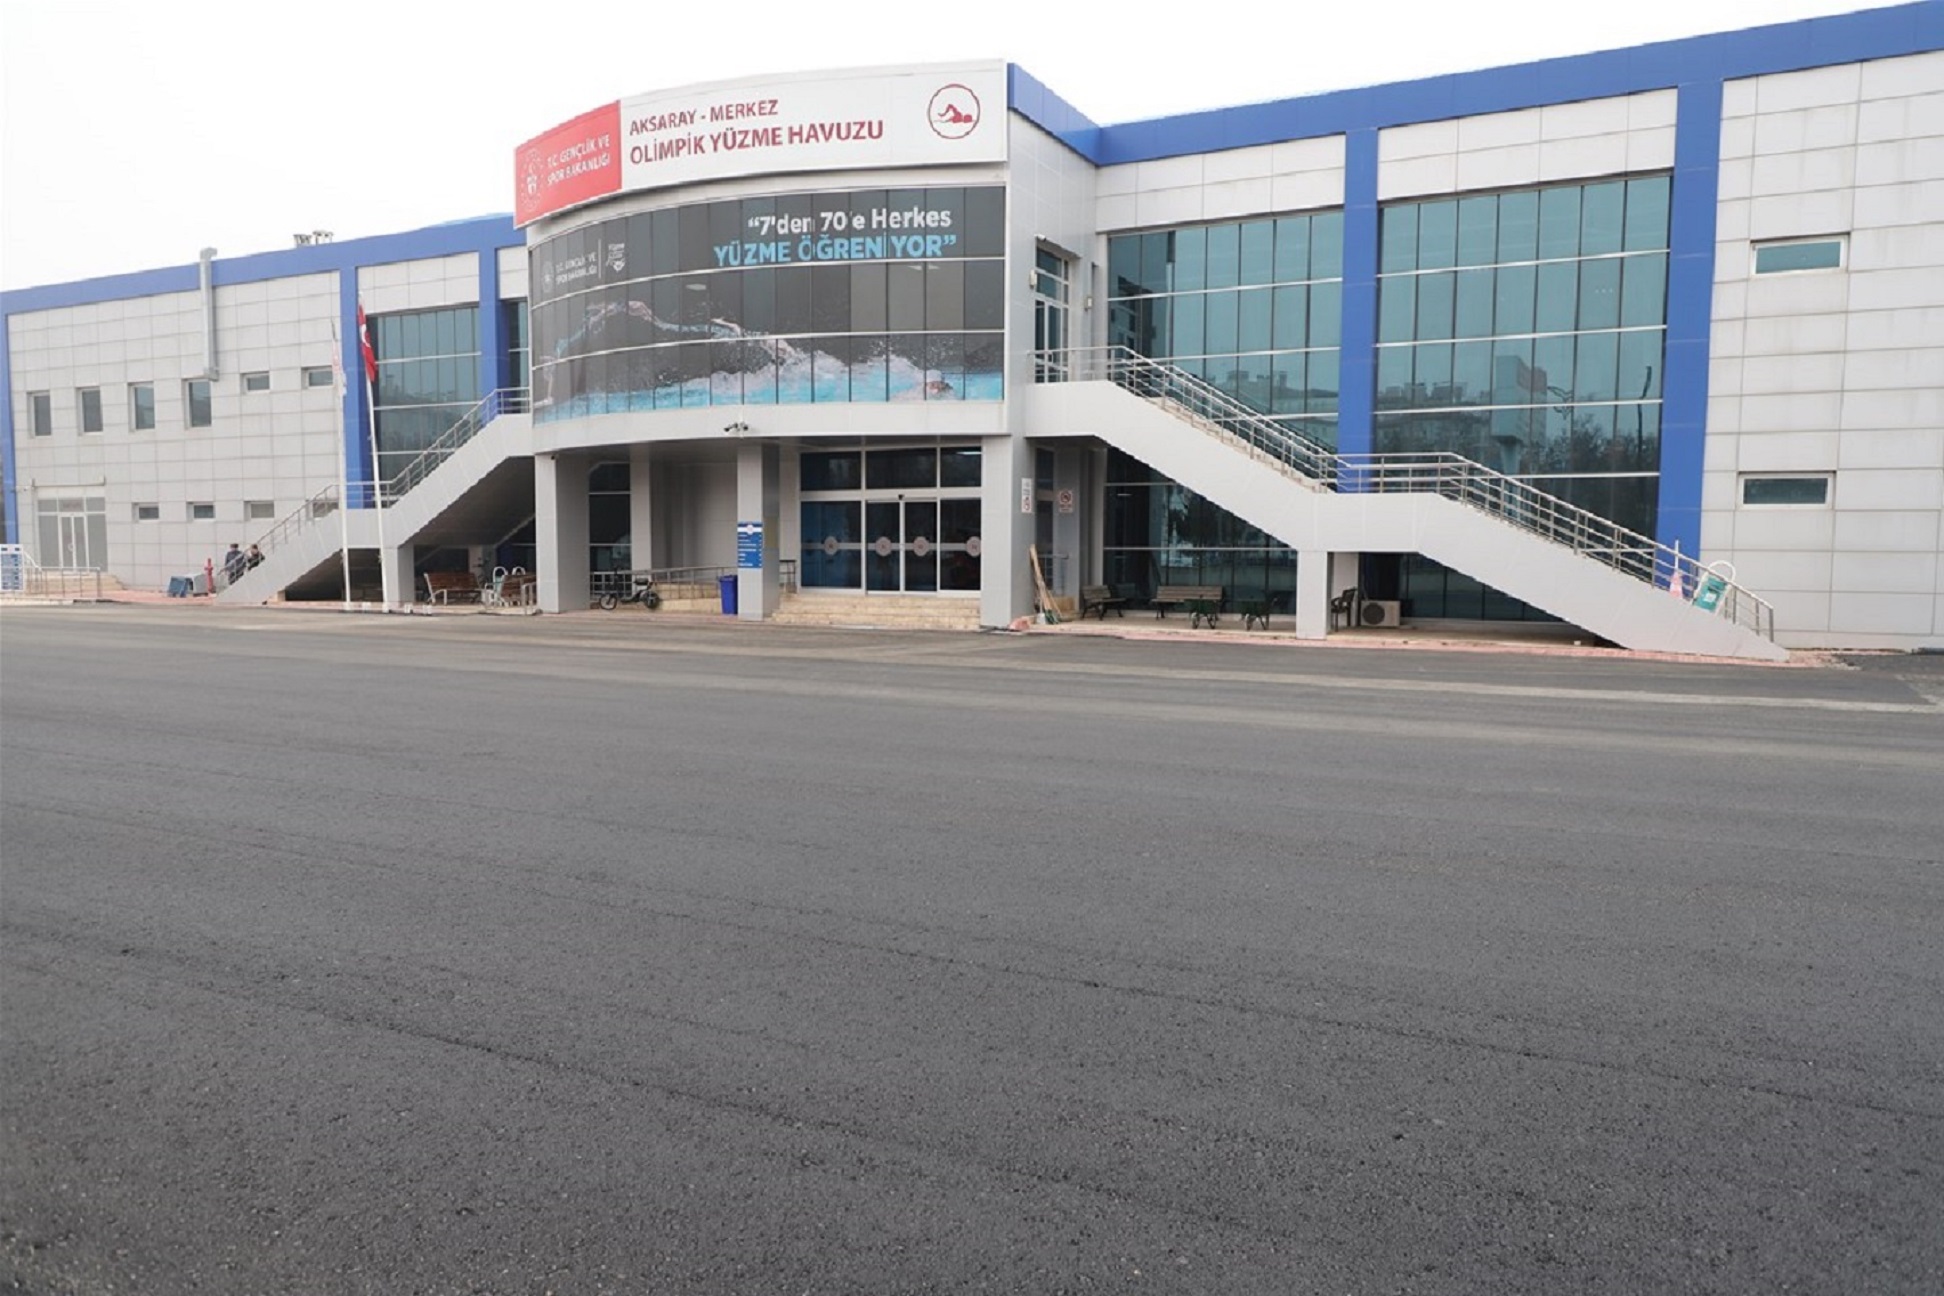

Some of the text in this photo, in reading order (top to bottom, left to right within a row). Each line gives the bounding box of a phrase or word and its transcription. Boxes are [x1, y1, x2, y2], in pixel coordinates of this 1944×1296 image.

[629, 109, 697, 136] AKSARAY
[709, 99, 779, 123] MERKEZ
[629, 120, 884, 165] OLİMPİK YÜZME HAVUZU
[871, 205, 953, 229] Herkes
[713, 240, 792, 267] YÜZME
